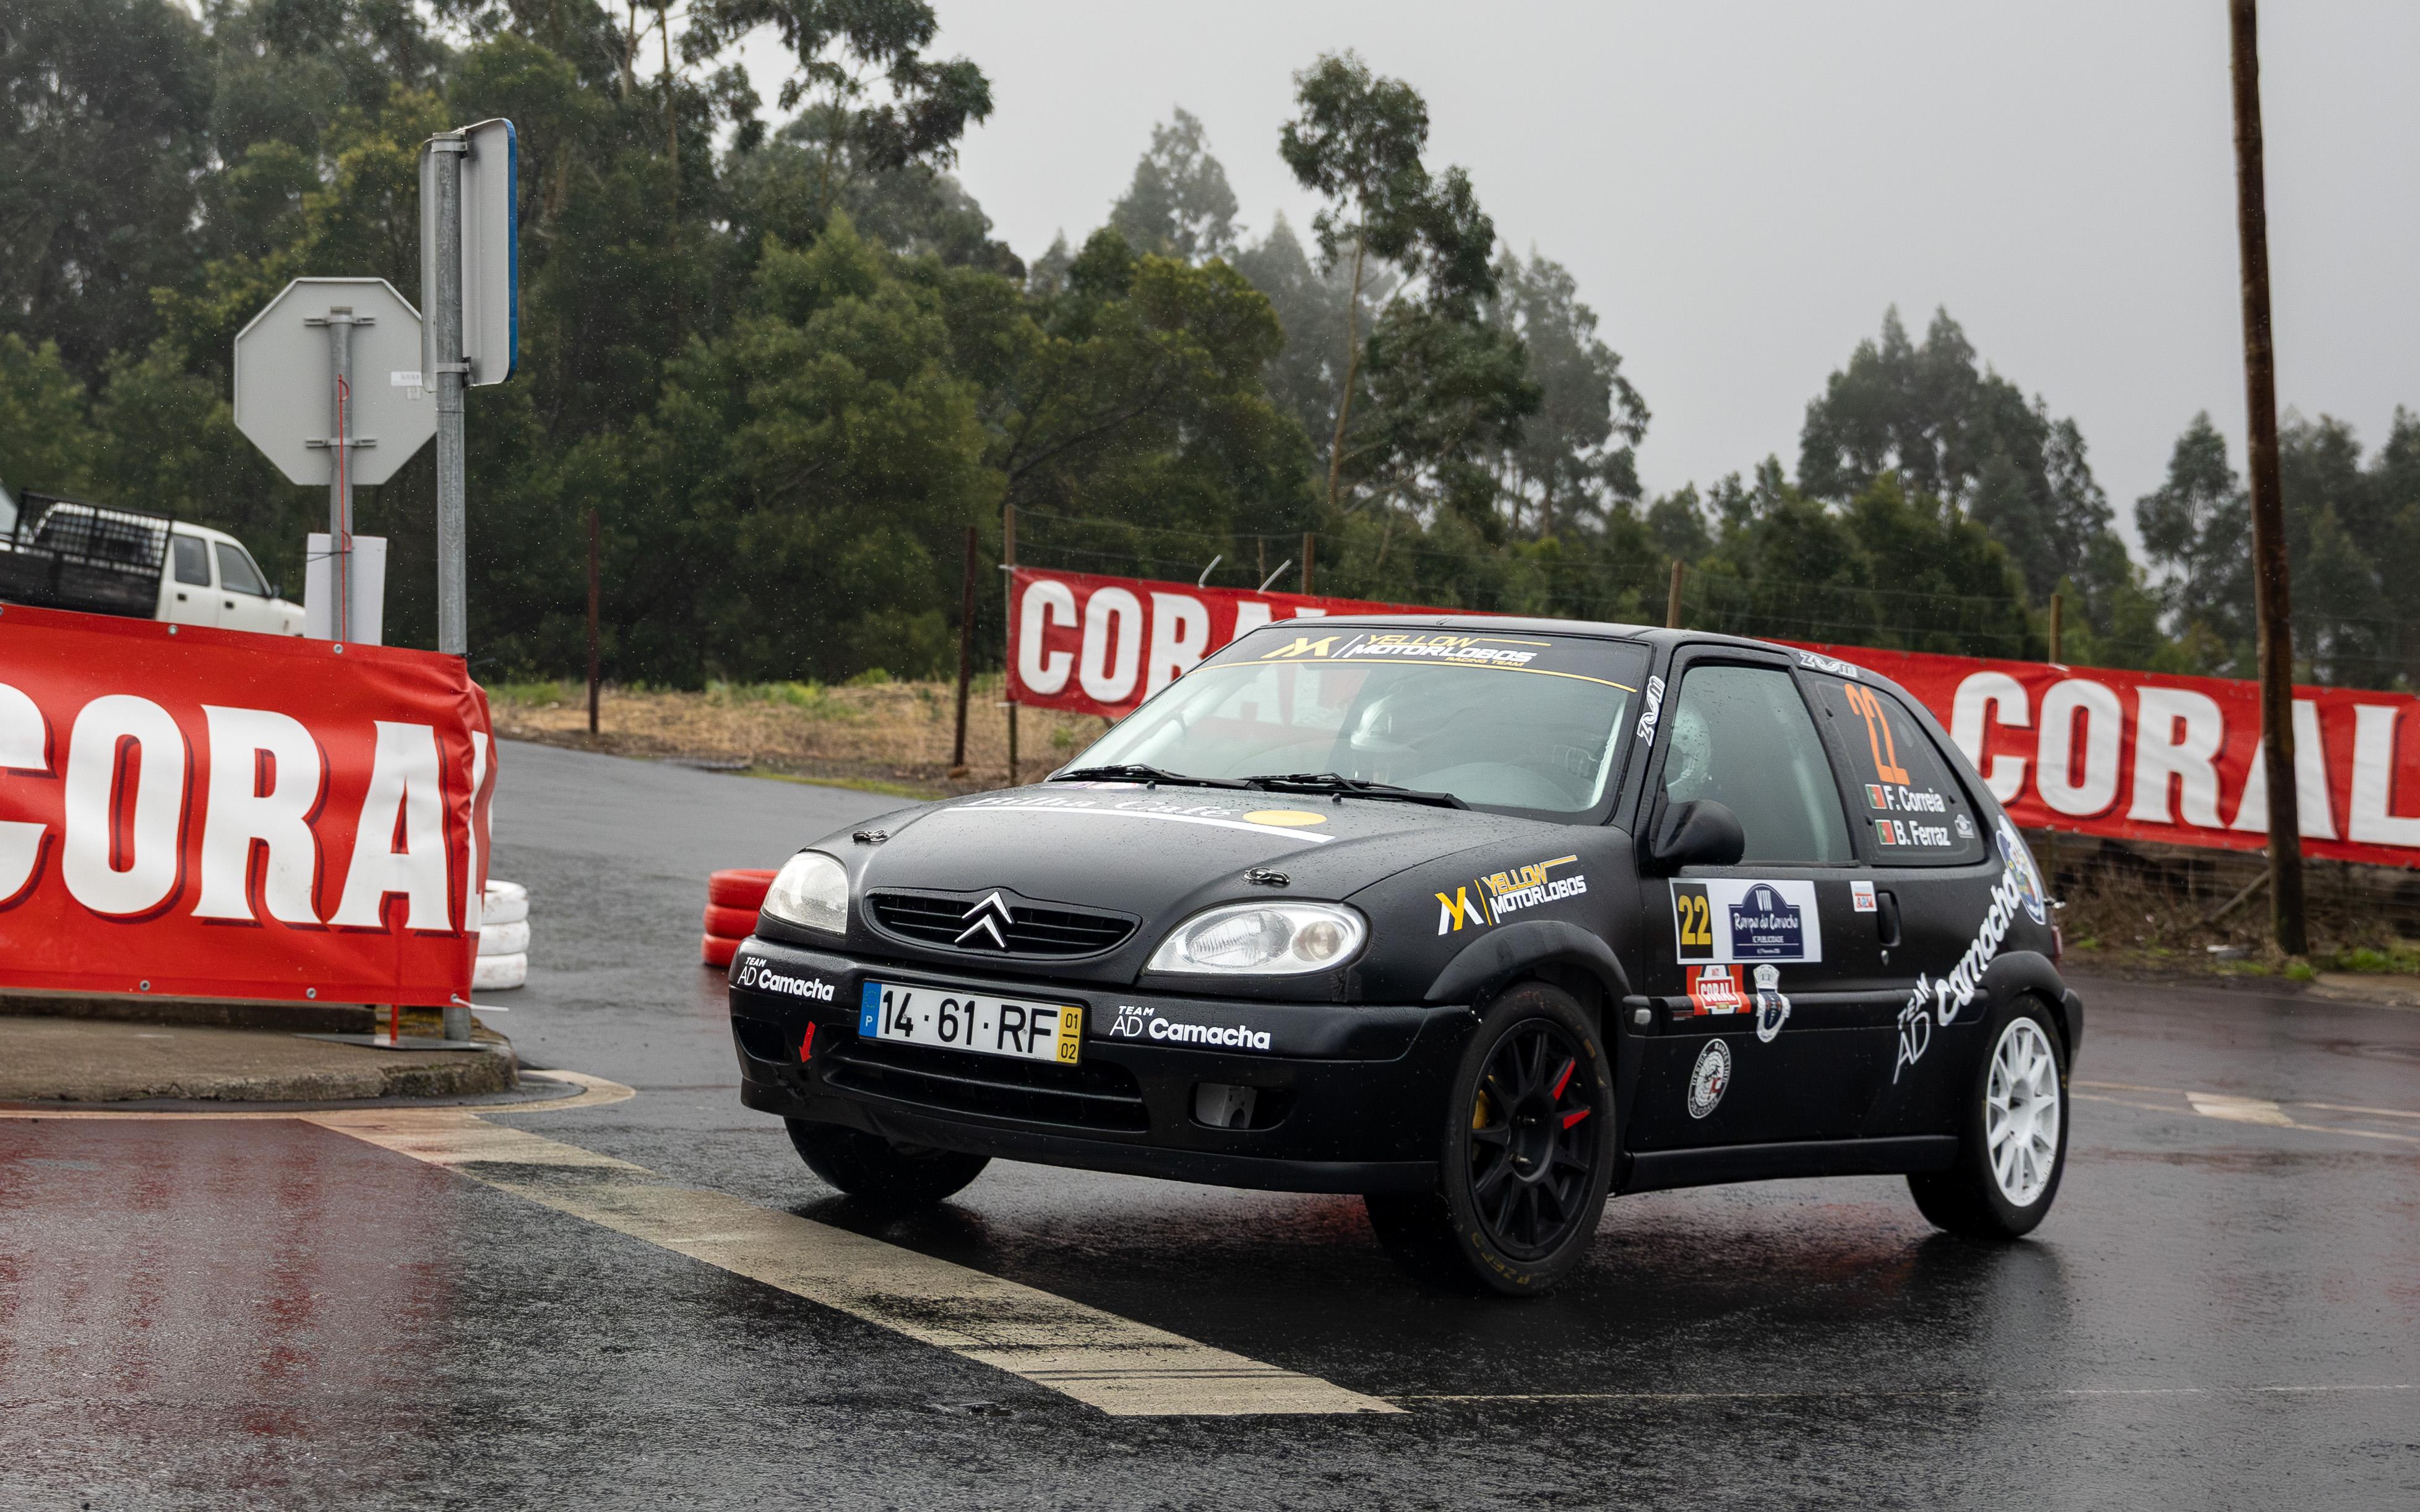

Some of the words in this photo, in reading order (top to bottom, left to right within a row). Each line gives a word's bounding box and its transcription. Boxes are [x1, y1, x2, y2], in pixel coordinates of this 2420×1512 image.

[1342, 644, 1538, 663] MOTORLOBOS
[1366, 634, 1480, 647] YELLOW
[1844, 683, 1911, 786] 22
[1883, 785, 1900, 811] F.
[1898, 786, 1946, 812] Correia
[1892, 820, 1912, 845] B.
[1908, 820, 1952, 846] Ferraz
[1481, 863, 1548, 896] YELLOW
[1489, 875, 1587, 924] MOTORLOBOS
[1755, 890, 1773, 911] VIII
[1678, 895, 1712, 945] 22
[744, 956, 767, 968] TEAM
[737, 965, 756, 986] AD
[758, 969, 835, 1002] Camacha
[1892, 1011, 1931, 1085] AD
[1934, 868, 2022, 1026] Camacha
[1700, 982, 1737, 1002] CORAL
[1898, 972, 1933, 1031] TEAM
[865, 1015, 873, 1027] P
[1065, 1013, 1079, 1029] 01
[1118, 1005, 1155, 1016] TEAM
[1109, 1015, 1142, 1037] AD
[1148, 1018, 1271, 1050] Camacha
[1061, 1043, 1077, 1060] 02
